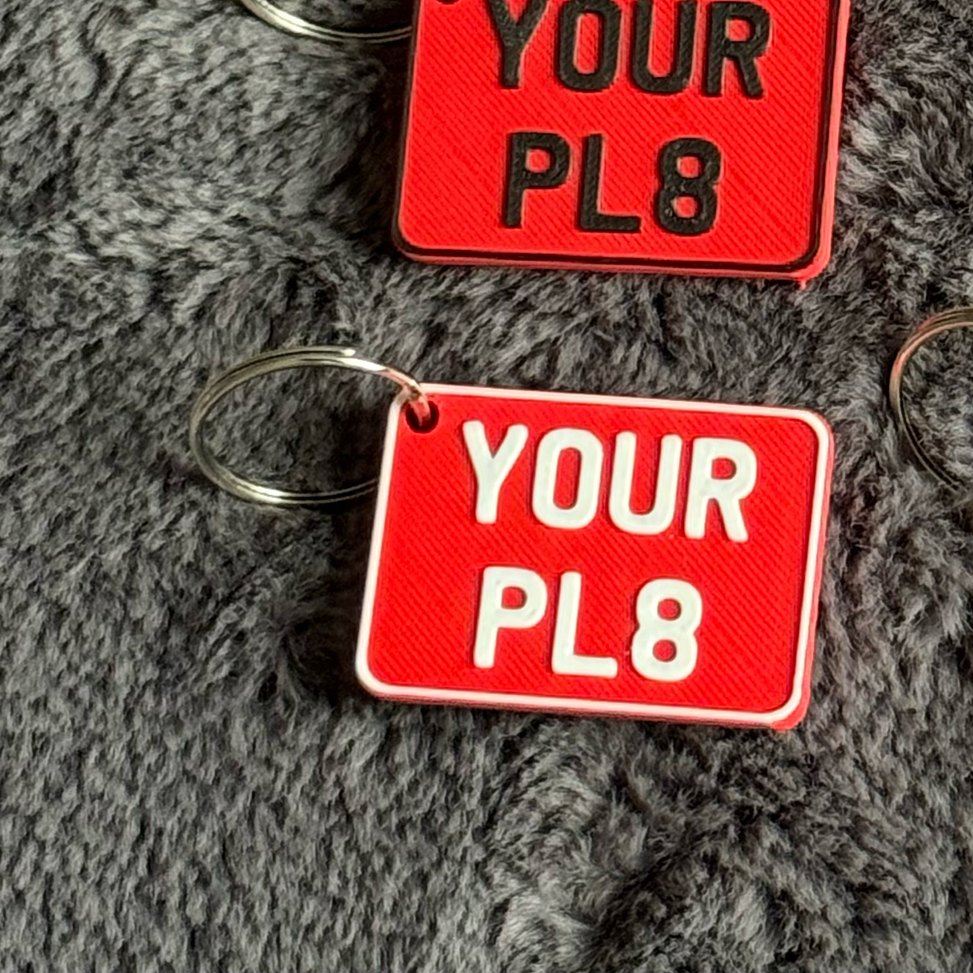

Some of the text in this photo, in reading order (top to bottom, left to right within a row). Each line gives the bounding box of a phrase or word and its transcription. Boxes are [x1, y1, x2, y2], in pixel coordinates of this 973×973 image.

[504, 131, 722, 236] PL8
[463, 420, 758, 542] YOUR
[474, 566, 703, 682] PL8
